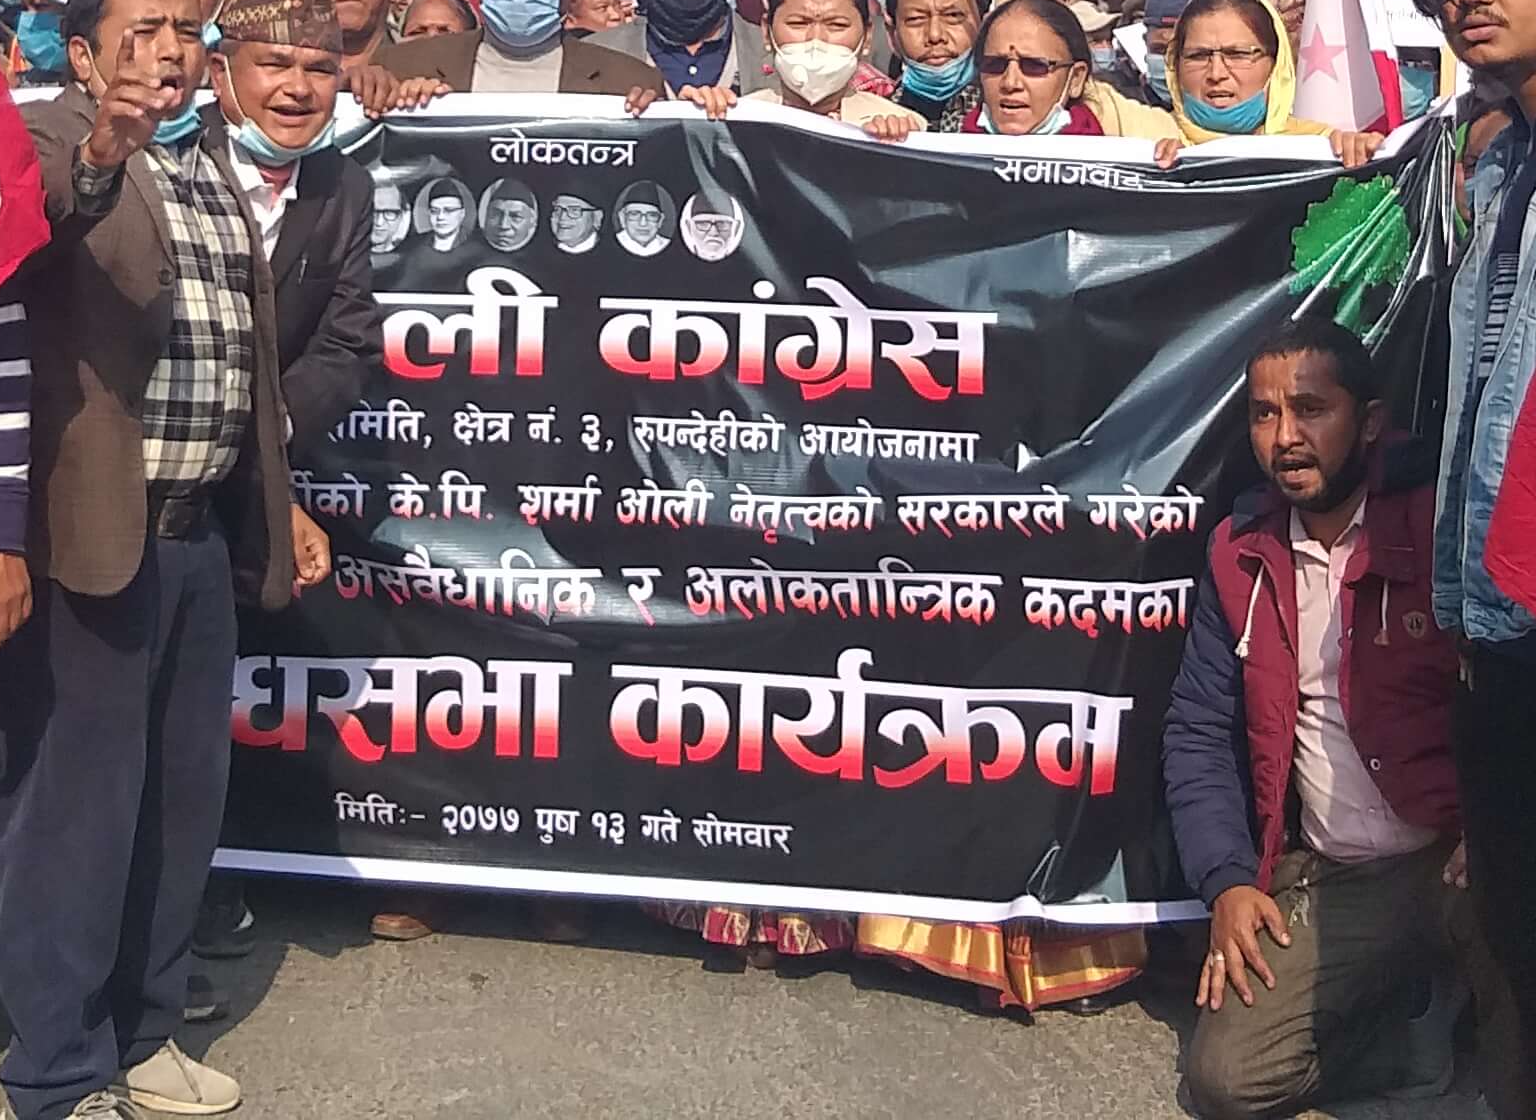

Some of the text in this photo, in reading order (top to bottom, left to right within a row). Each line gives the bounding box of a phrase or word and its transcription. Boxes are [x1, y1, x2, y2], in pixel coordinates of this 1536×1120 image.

[490, 128, 639, 168] लोकतन्त्र
[373, 265, 998, 401] ली कांग्रेस
[453, 401, 515, 444] क्षेत्र
[527, 406, 562, 444] नं.
[581, 414, 614, 453] ३,
[633, 407, 785, 458] रुपन्देहीको
[799, 418, 981, 463] आयोजनामा
[387, 469, 495, 521] के.पि.
[517, 474, 603, 526] शर्मा
[616, 476, 713, 530] ओली
[729, 483, 883, 544] नेतृत्वको
[896, 484, 1070, 539] सरकारले
[1087, 484, 1205, 541] गरेको
[621, 565, 662, 627] र
[686, 556, 1003, 625] अलोकतान्त्रिक
[1022, 576, 1194, 638] कदमका
[232, 647, 1133, 794] धसभा कार्यक्रम
[441, 804, 521, 837] २०७७
[591, 813, 626, 847] १३
[641, 810, 681, 844] गते
[691, 814, 793, 855] सोमवार
